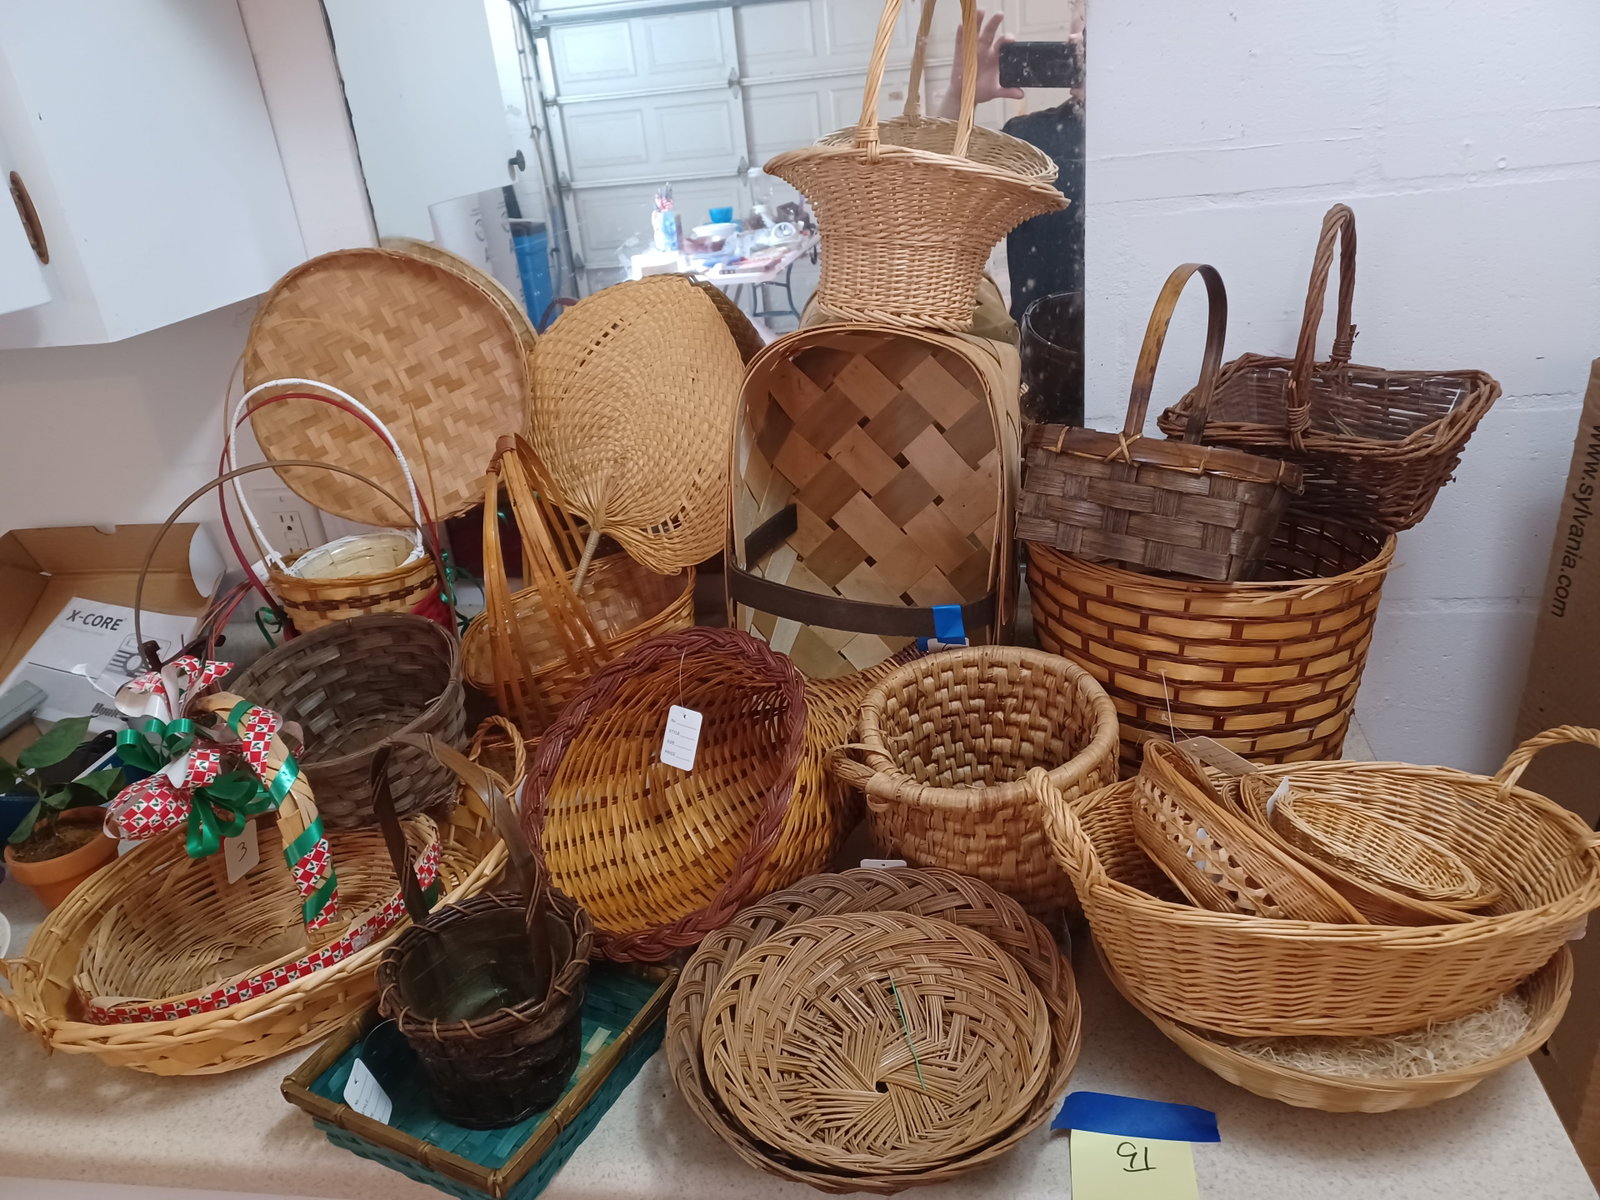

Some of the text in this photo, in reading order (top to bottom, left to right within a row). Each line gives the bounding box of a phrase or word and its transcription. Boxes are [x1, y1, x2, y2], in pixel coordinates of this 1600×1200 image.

[1552, 425, 1600, 618] www.sylvania.com
[66, 609, 123, 631] X-CORE
[236, 841, 248, 863] 3
[1116, 1141, 1156, 1172] 91
